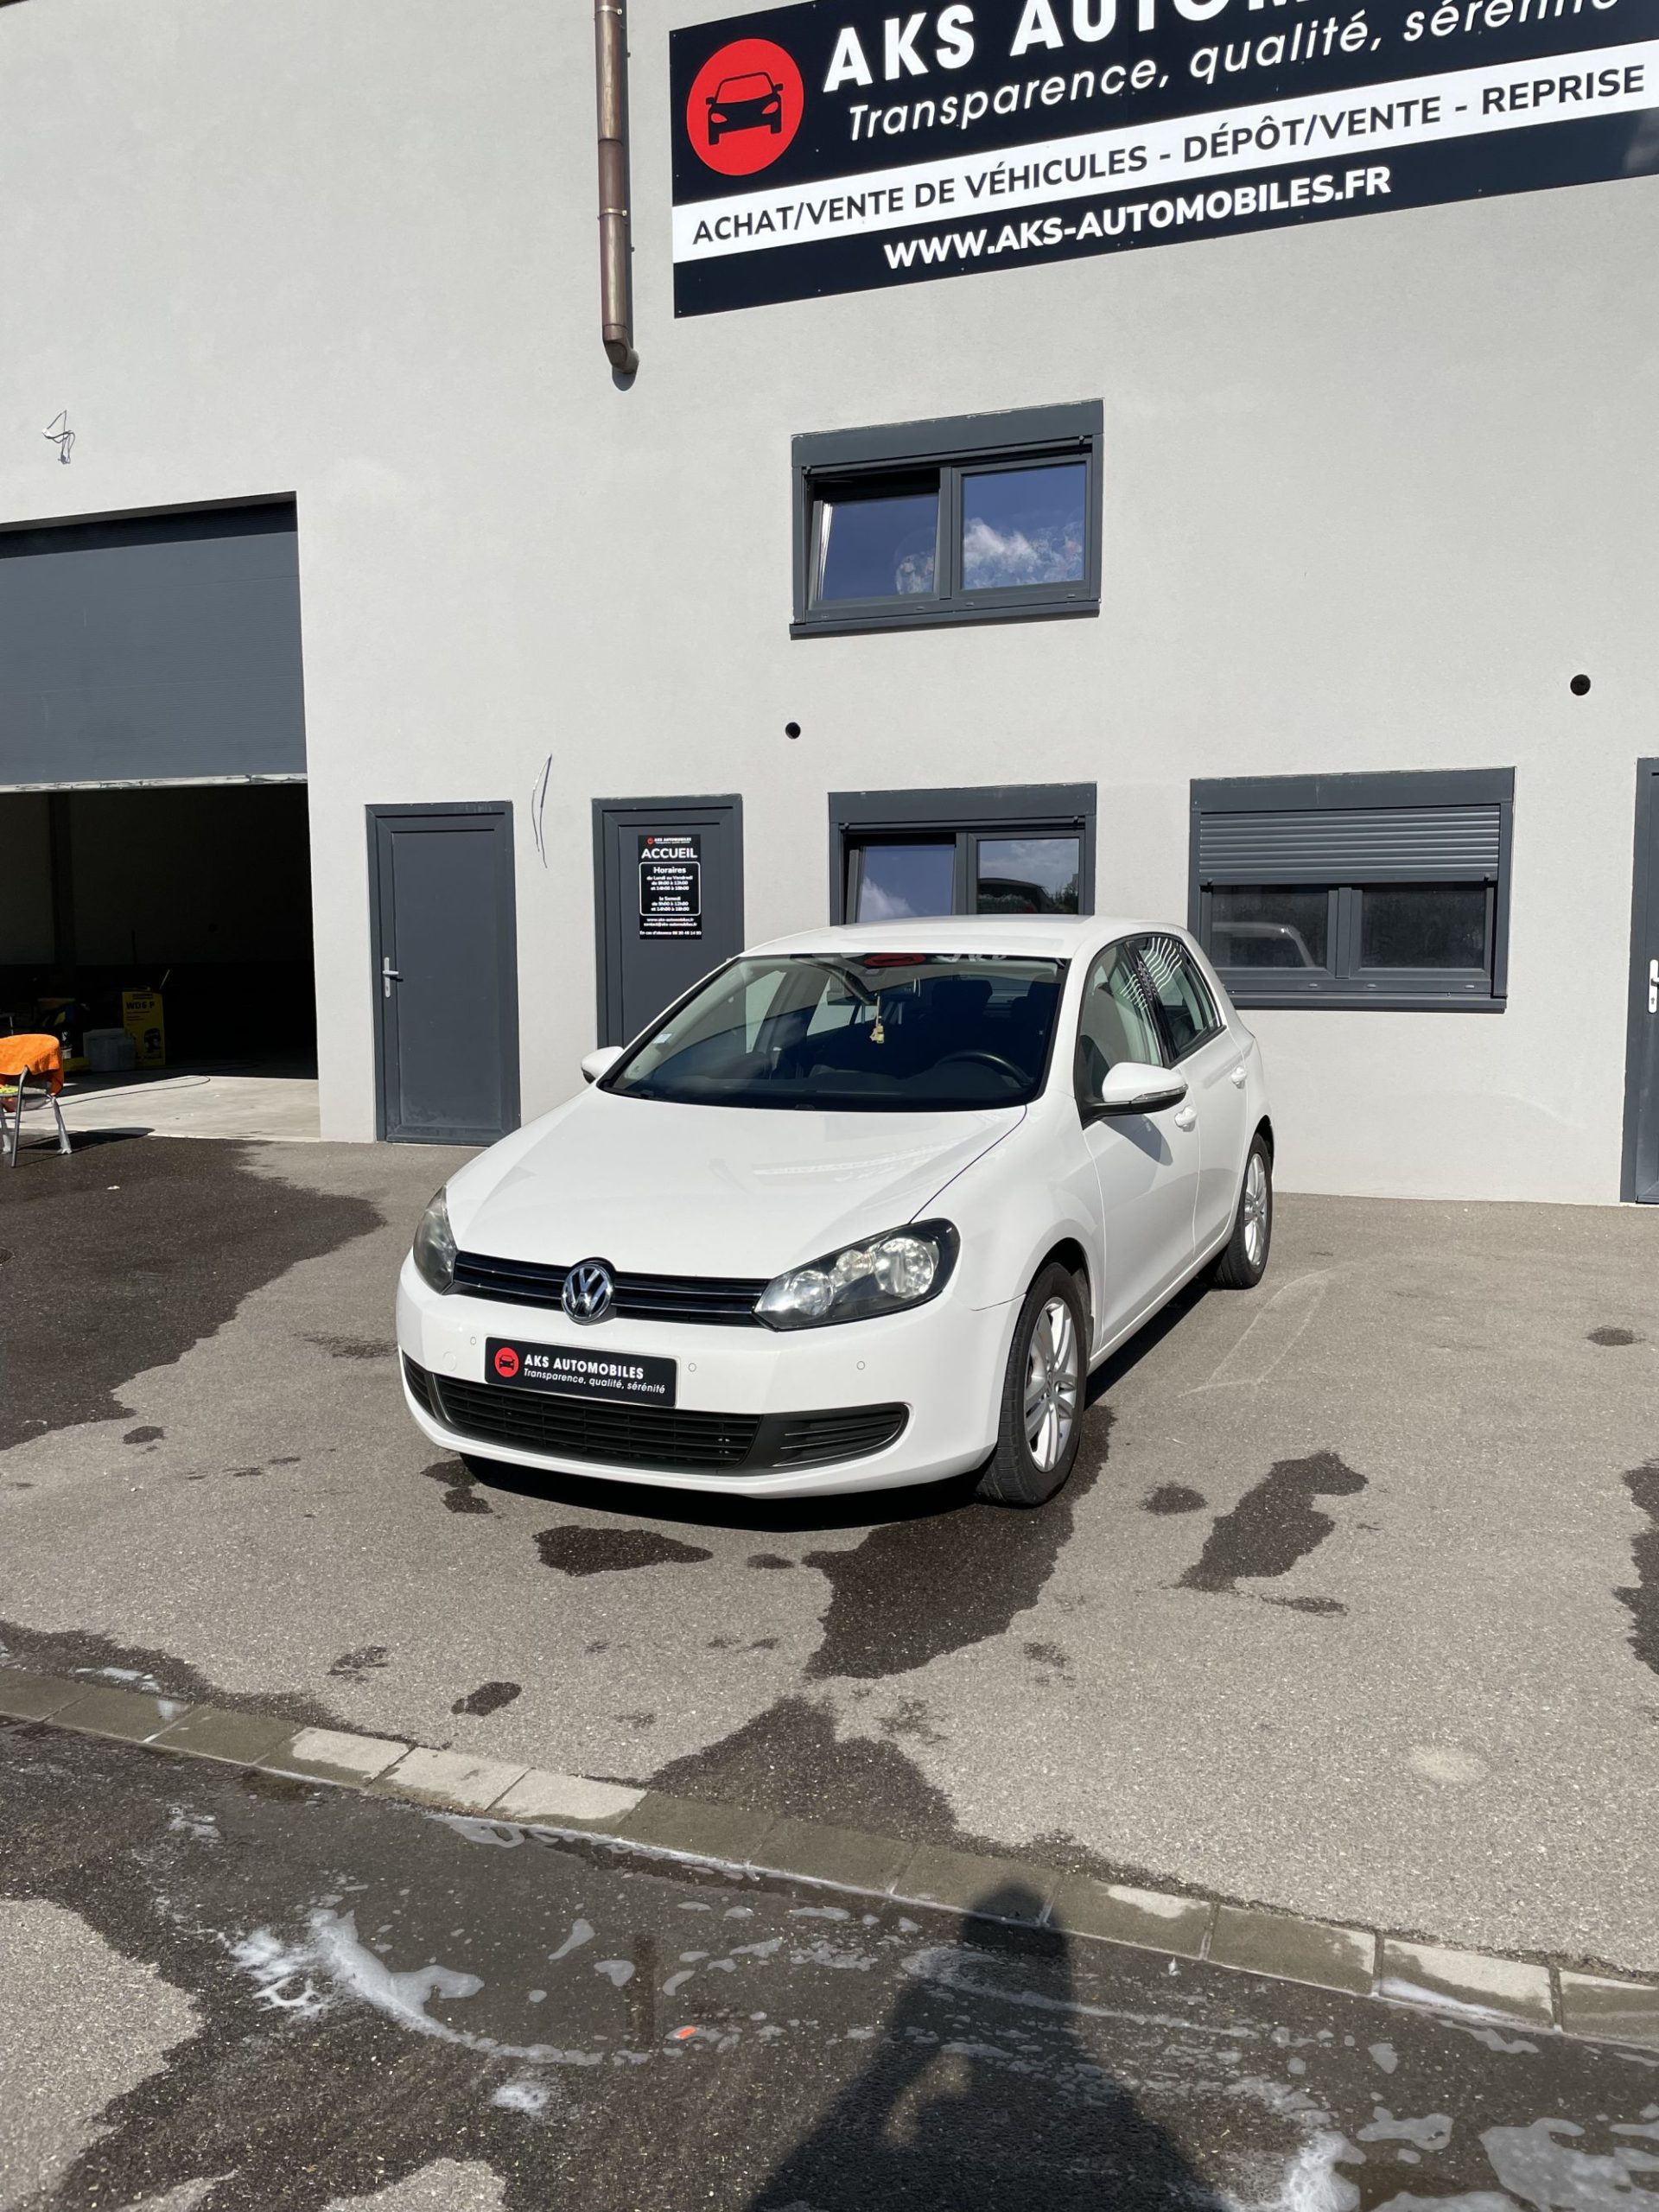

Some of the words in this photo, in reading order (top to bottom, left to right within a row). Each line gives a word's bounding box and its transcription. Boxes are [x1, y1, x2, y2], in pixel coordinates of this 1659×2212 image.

[823, 4, 975, 93] AKS
[849, 59, 1169, 141] Transparence,
[1189, 10, 1382, 84] qualité,
[1402, 0, 1620, 41] sérén
[692, 187, 904, 245] ACHAT/VENTE
[914, 179, 955, 207] DE
[965, 145, 1148, 200] VÉHICULES
[1183, 96, 1442, 163] DÉPÔT/VENTE
[1481, 64, 1646, 116] REPRISE
[883, 165, 1392, 270] WWW.AKS-AUTOMOBILES.FR
[641, 848, 698, 859] ACCUEIL
[524, 1354, 550, 1369] AKS
[553, 1357, 645, 1380] AUTOMOBILES
[524, 1368, 587, 1386] Transparence,
[588, 1376, 625, 1390] qualité,
[626, 1381, 666, 1395] sérénité
